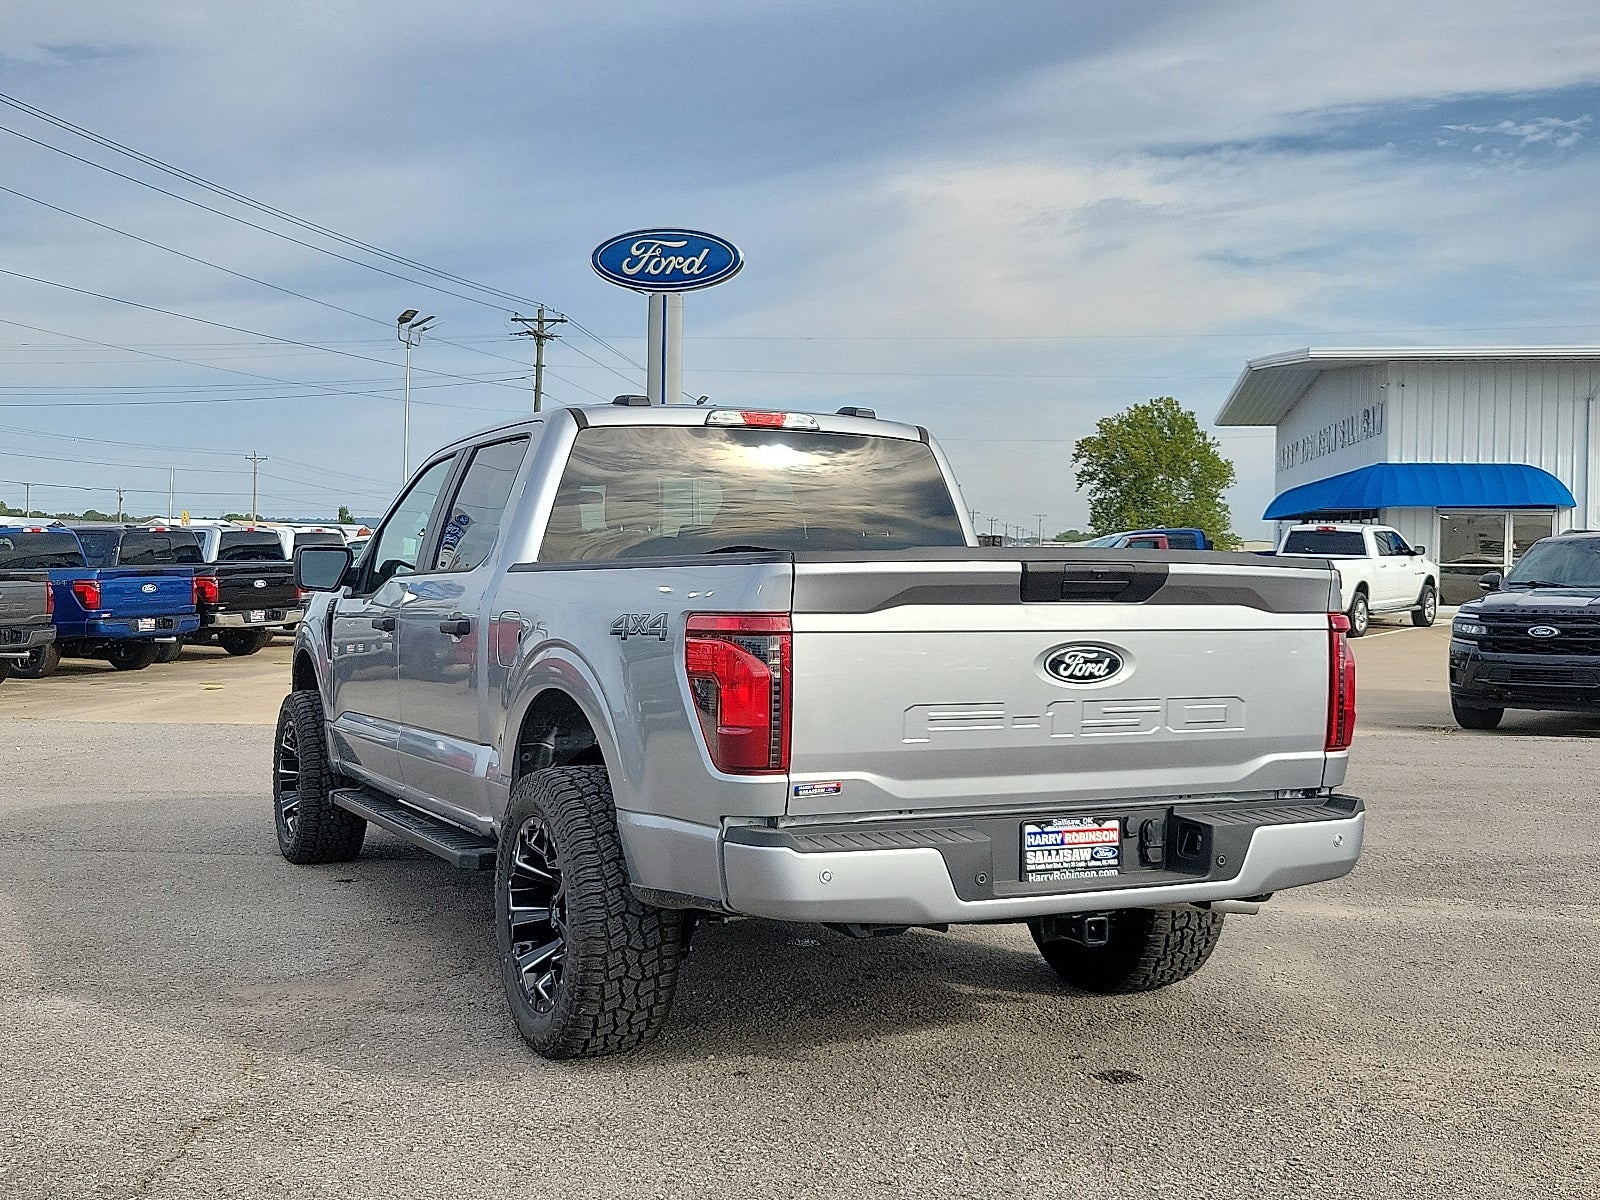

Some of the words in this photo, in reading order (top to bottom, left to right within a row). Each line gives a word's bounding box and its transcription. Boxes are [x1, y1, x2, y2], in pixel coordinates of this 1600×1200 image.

[622, 239, 709, 275] Ford
[1059, 650, 1110, 677] Ford
[902, 696, 1246, 744] F-150
[1026, 833, 1062, 846] HARRY
[1064, 830, 1117, 844] ROBINSON
[1026, 848, 1092, 864] SALLISAW
[1028, 868, 1119, 883] HarryRobinson.com
